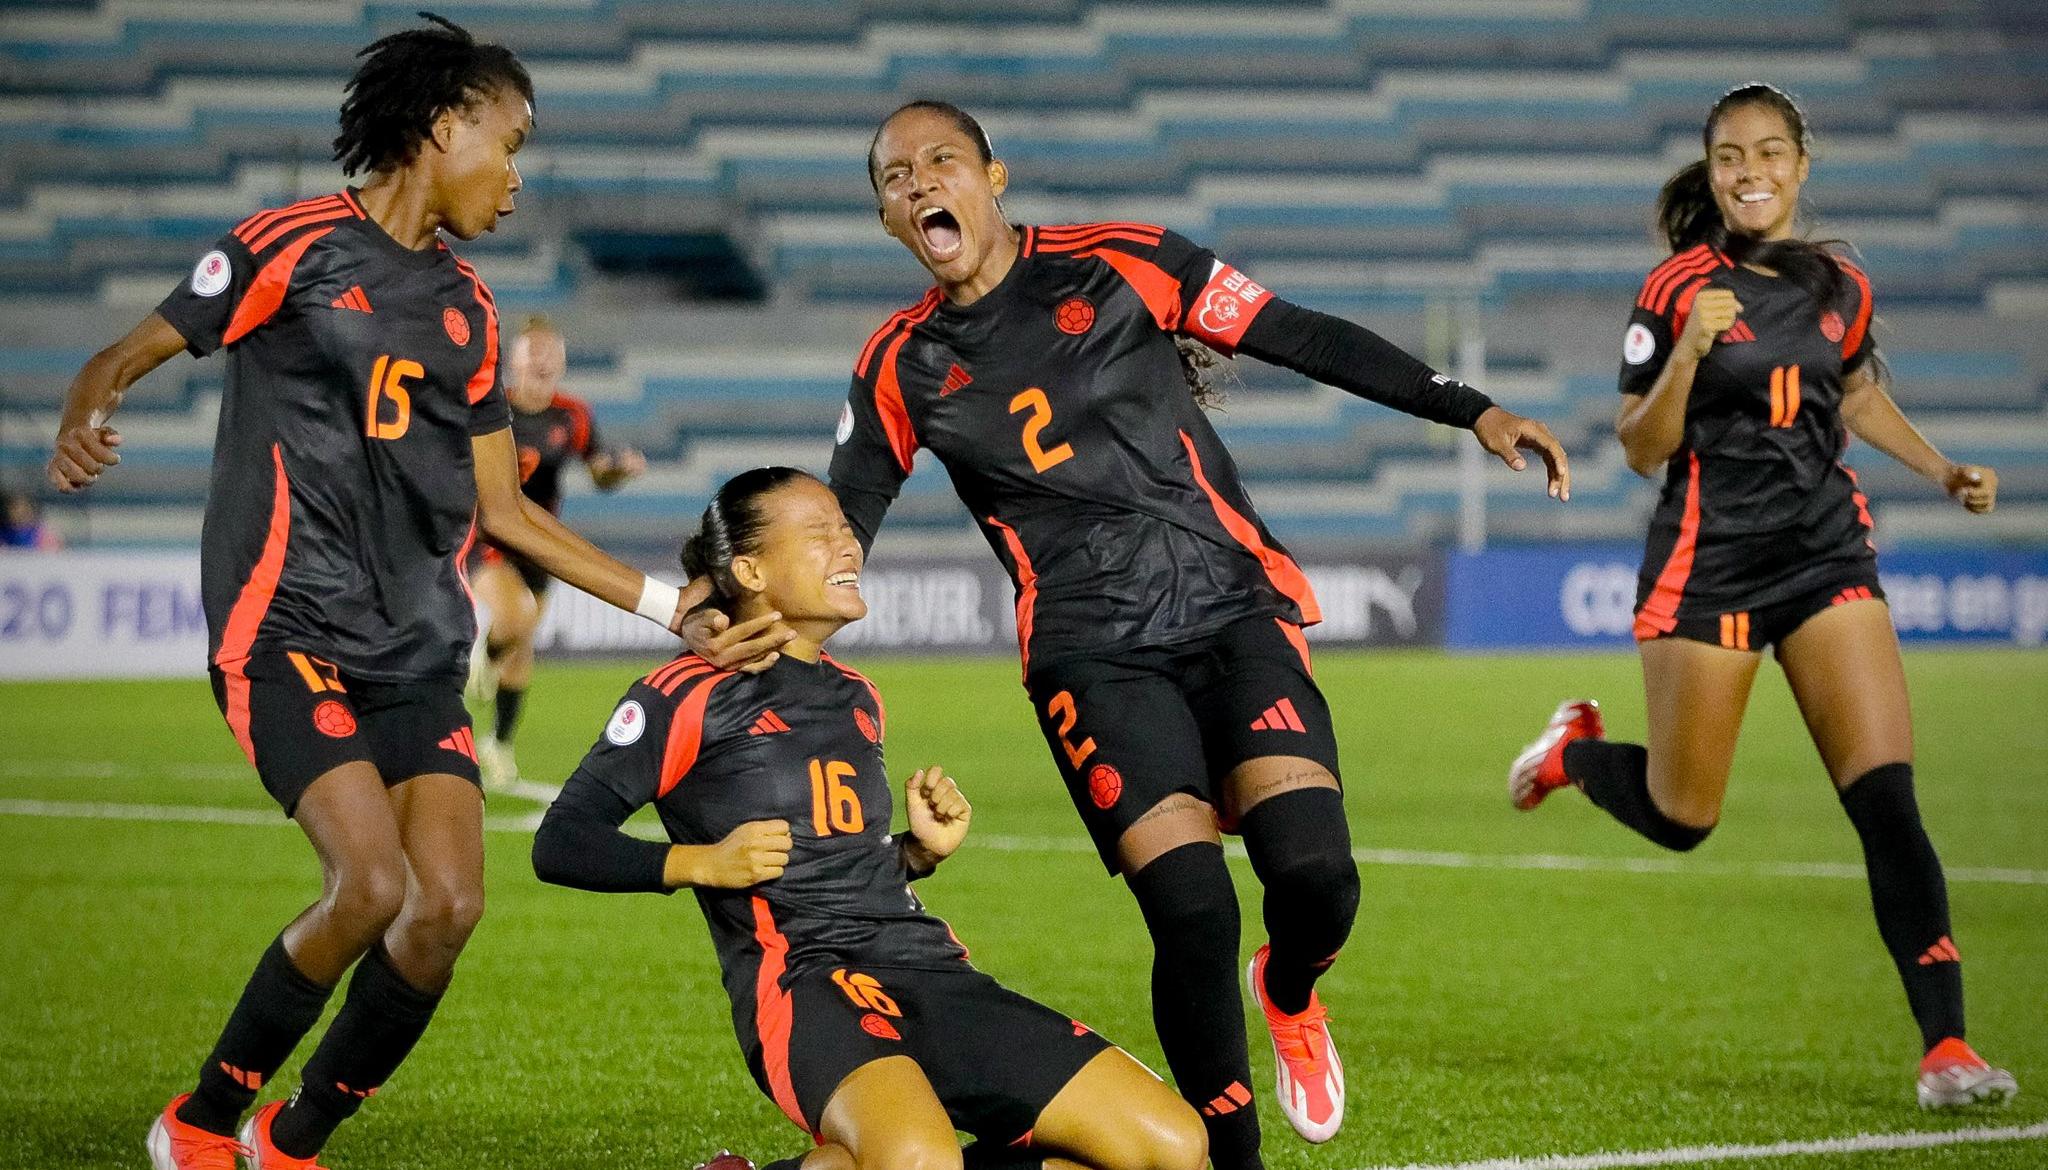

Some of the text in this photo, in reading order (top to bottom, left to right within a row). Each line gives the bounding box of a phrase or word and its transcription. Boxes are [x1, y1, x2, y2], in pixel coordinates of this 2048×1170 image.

[367, 354, 425, 441] 15
[1009, 387, 1075, 474] 2
[1769, 364, 1800, 428] 11
[2, 579, 71, 638] 20
[1720, 612, 1750, 651] 11
[1048, 690, 1097, 770] 2
[809, 758, 865, 837] 16
[831, 968, 903, 1017] 16
